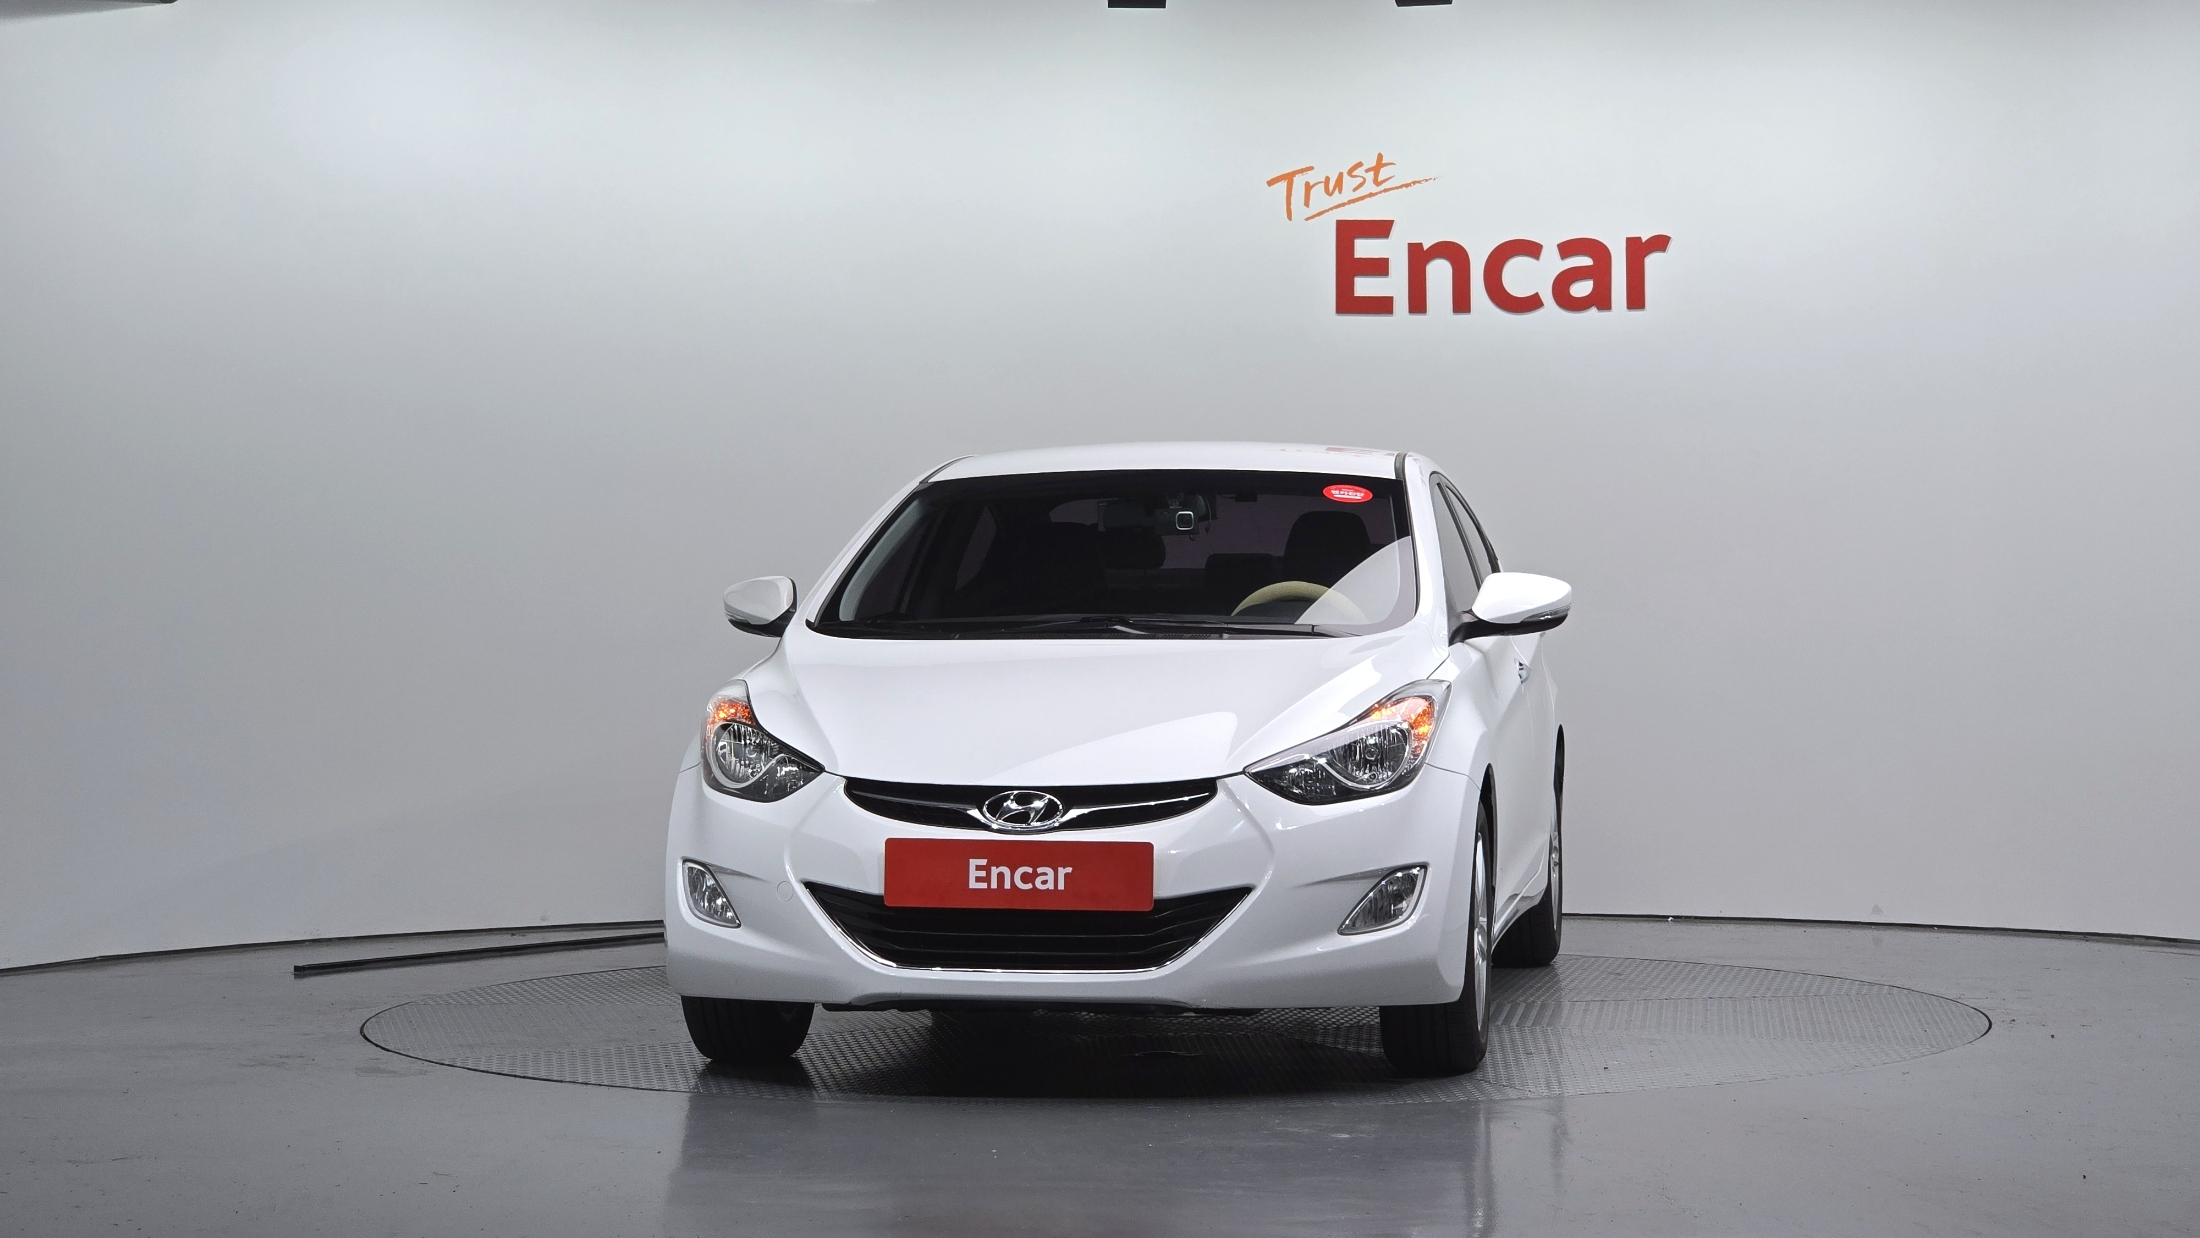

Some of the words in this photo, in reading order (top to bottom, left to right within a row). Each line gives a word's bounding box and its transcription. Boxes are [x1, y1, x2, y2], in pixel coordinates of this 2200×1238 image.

[1267, 152, 1396, 221] Trust
[1335, 219, 1671, 315] Encar
[968, 858, 1073, 890] Encar
